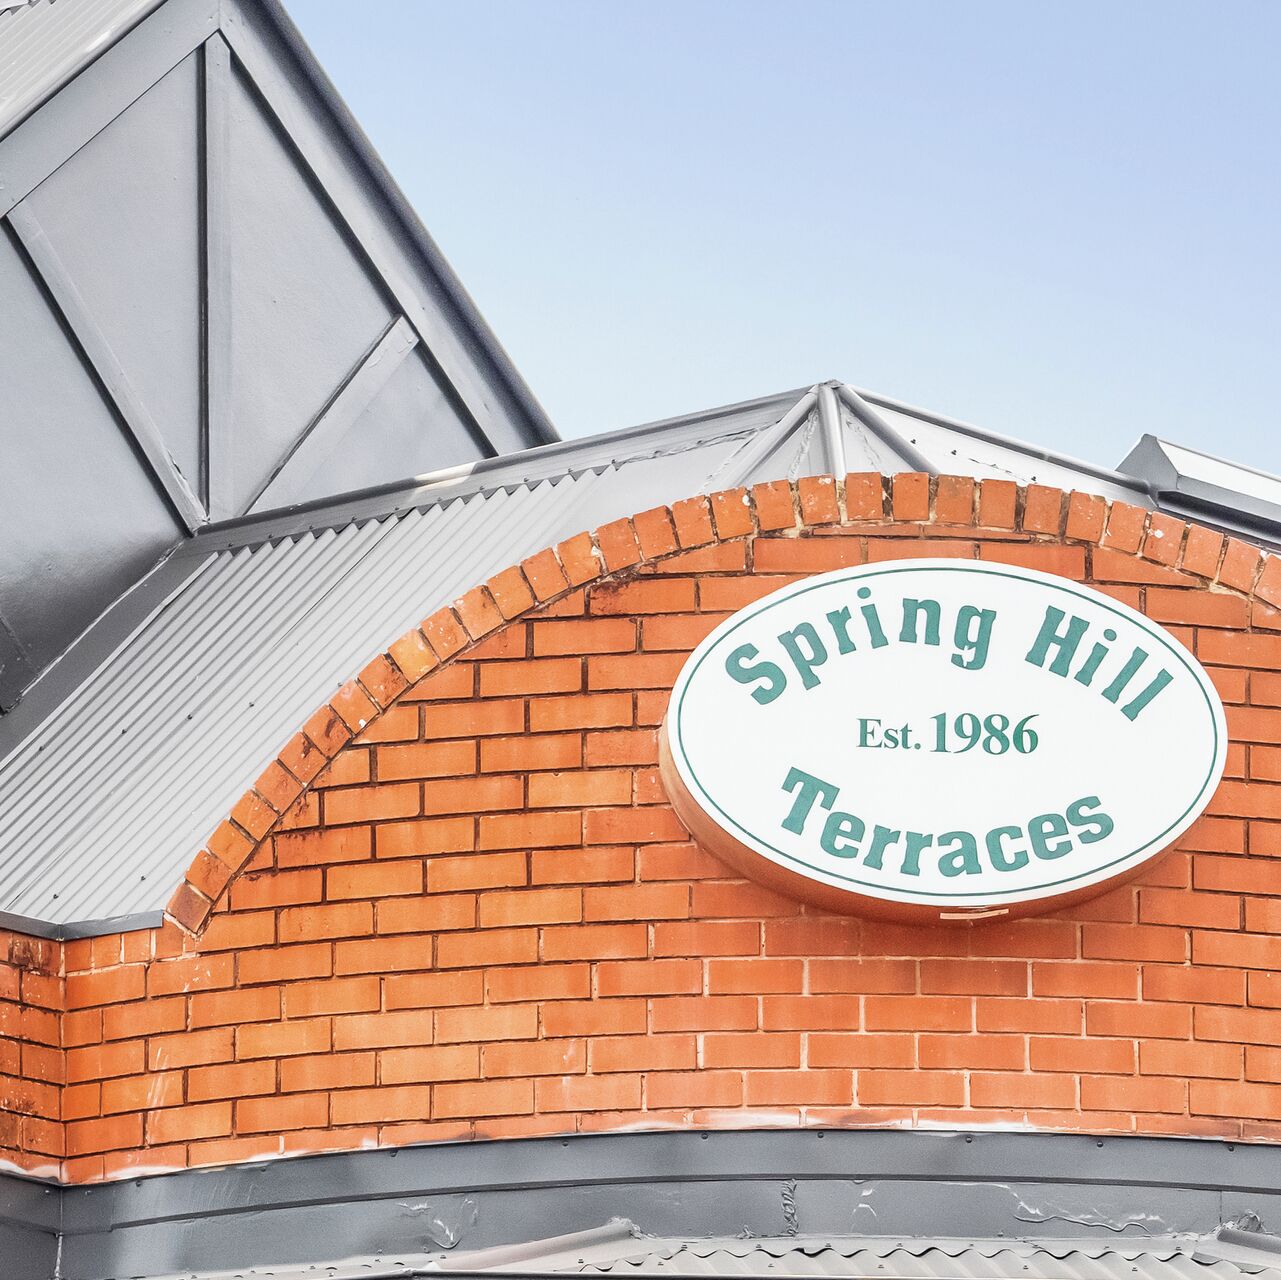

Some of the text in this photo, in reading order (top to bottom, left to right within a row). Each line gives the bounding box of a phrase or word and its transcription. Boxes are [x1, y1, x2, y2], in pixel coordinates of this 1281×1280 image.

[725, 586, 1174, 721] Spring Hill
[857, 712, 1039, 755] Est. 1986
[781, 767, 1114, 877] Terraces
